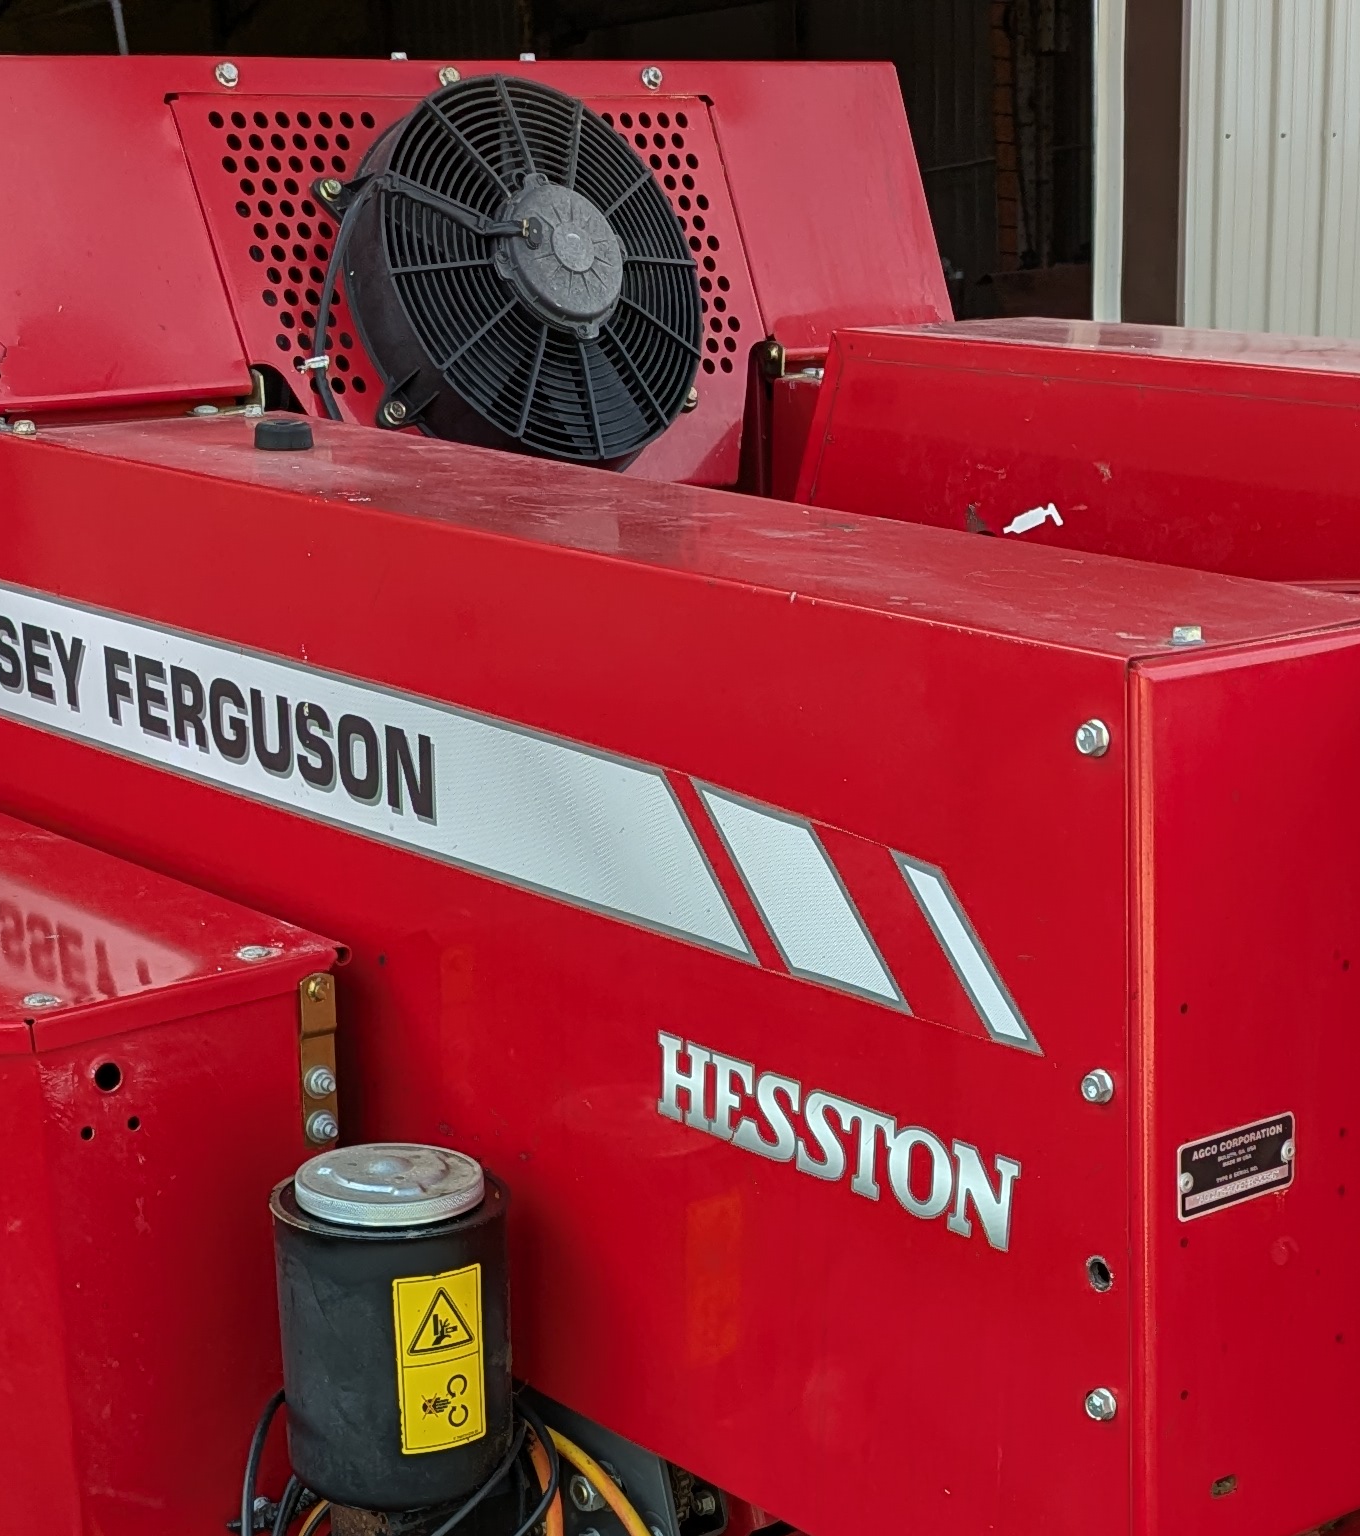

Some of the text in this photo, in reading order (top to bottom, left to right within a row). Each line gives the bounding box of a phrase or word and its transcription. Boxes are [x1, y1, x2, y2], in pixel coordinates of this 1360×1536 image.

[104, 647, 439, 827] FERGUSON
[655, 1029, 1022, 1253] HESSTON
[1192, 1145, 1218, 1161] AGCO
[1219, 1124, 1283, 1152] CORPORATION
